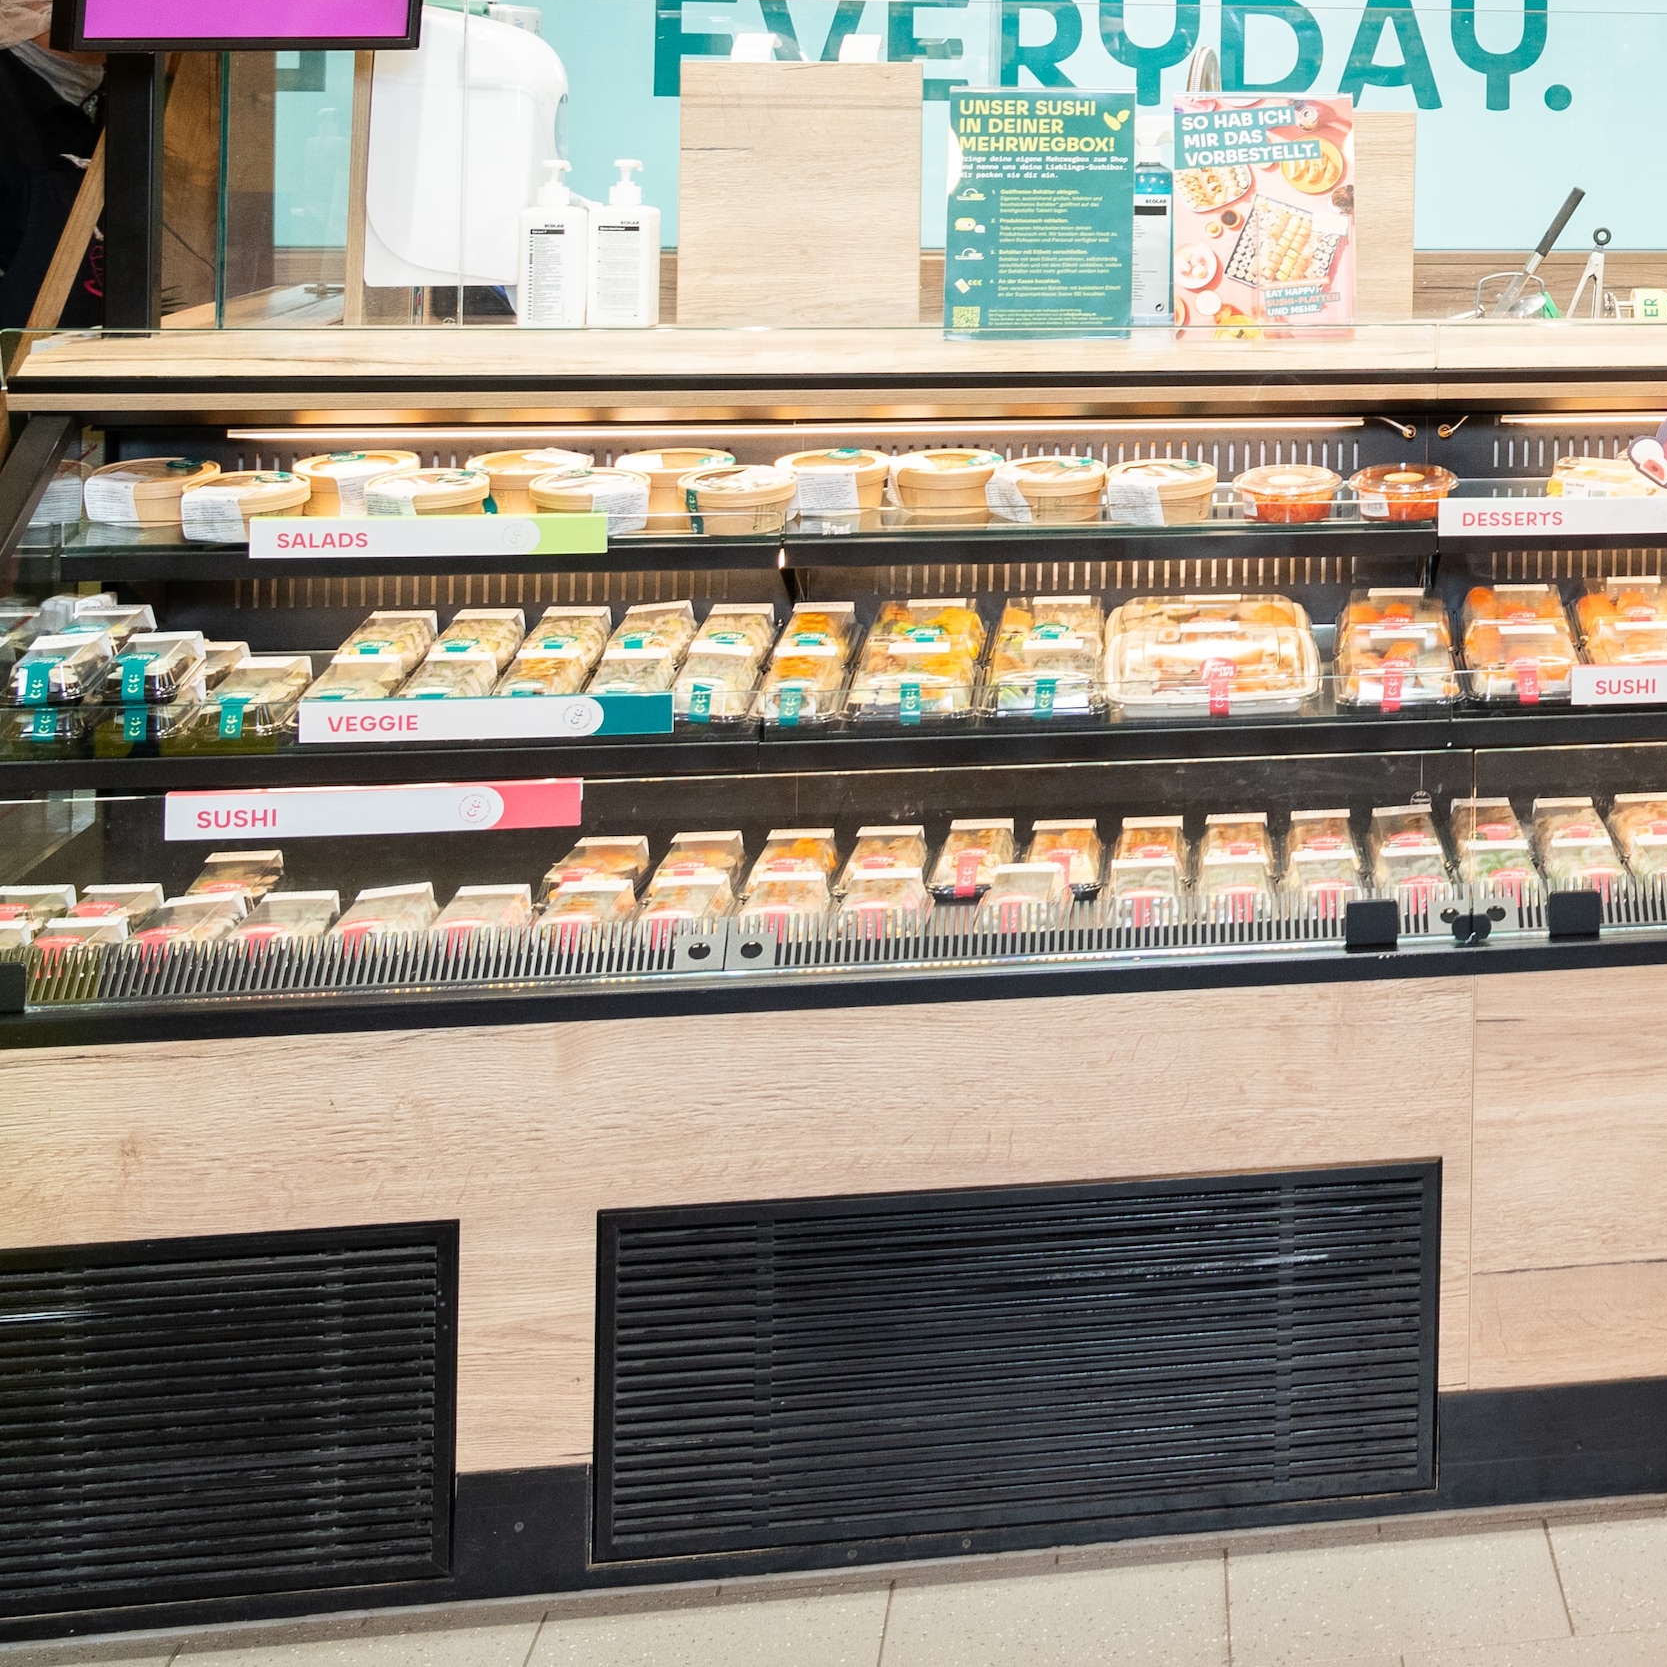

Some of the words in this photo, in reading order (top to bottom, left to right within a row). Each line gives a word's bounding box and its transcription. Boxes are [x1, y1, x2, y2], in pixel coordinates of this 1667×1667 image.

[959, 99, 1030, 116] UNSER
[1034, 99, 1097, 117] SUSHI
[958, 117, 984, 134] IN
[987, 118, 1065, 134] DEINER
[1180, 115, 1209, 131] SO
[1213, 112, 1253, 129] HAB
[1257, 109, 1292, 126] ICH
[959, 136, 1116, 153] MEHRWEGBOX!
[1183, 132, 1219, 150] MIR
[1223, 129, 1263, 146] DAS
[1015, 155, 1043, 164] eigene
[1045, 155, 1090, 164] Mehrwegbox
[1109, 155, 1129, 164] Shop
[1184, 142, 1318, 167] VORBESTELLT.
[1265, 289, 1284, 298] EAT
[1284, 286, 1316, 297] HAPPY
[1267, 306, 1289, 316] UND
[1290, 303, 1321, 314] MEHR.
[1461, 510, 1564, 528] DESSERTS
[275, 531, 369, 550] SALADS
[1594, 677, 1657, 696] SUSHI
[326, 713, 420, 733] VEGGIE
[195, 808, 278, 829] SUSHI
